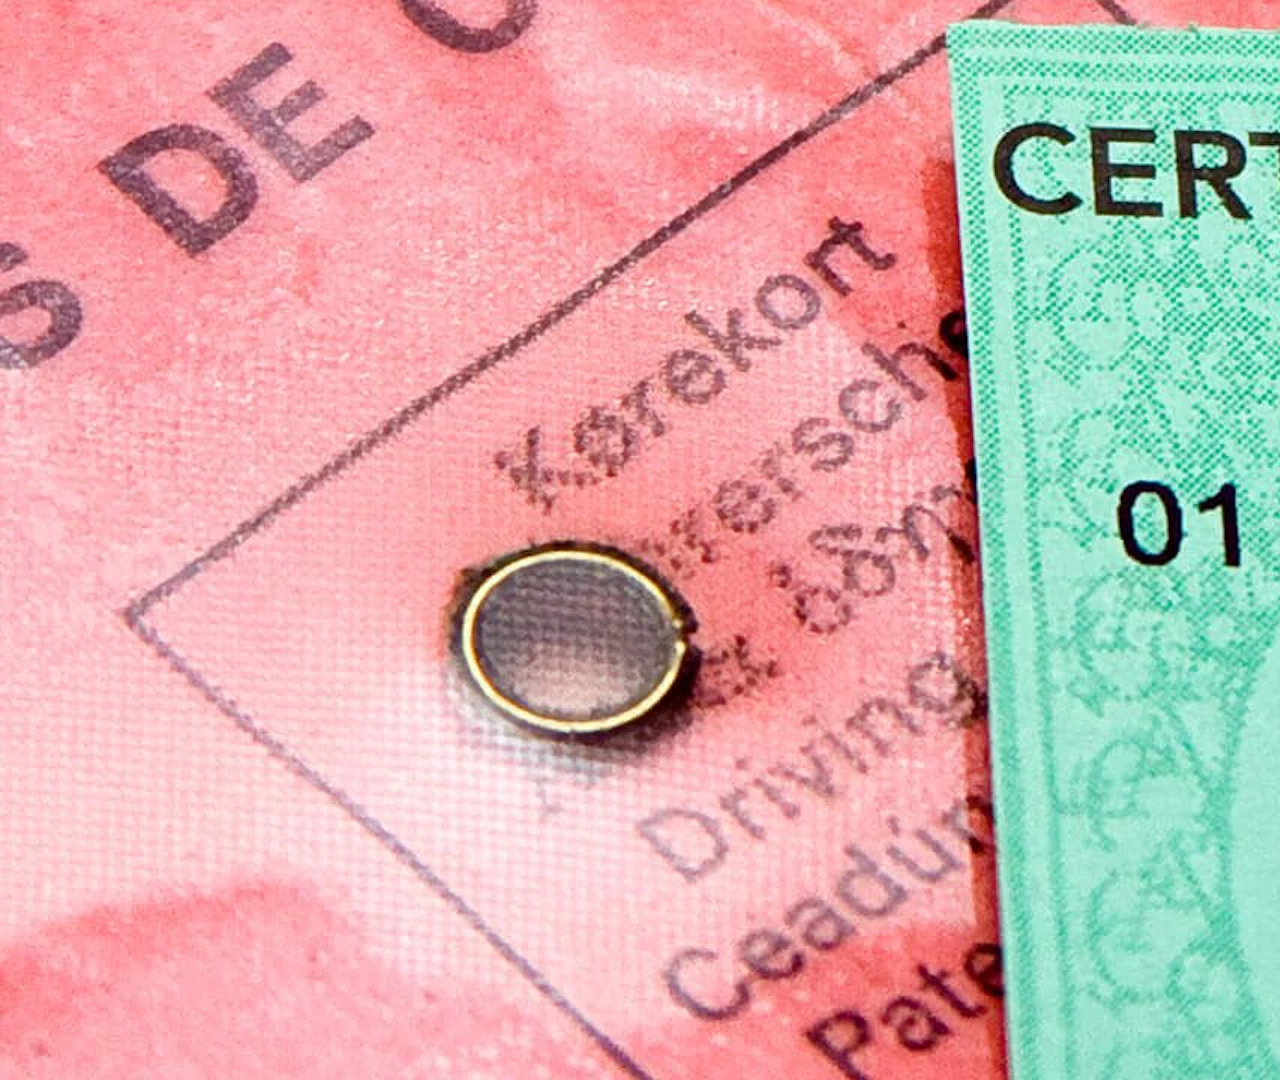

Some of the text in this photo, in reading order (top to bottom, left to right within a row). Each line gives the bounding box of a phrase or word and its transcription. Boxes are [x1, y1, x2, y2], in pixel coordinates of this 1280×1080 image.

[98, 41, 376, 259] DE
[496, 216, 898, 512] Kørekort
[1115, 479, 1243, 569] 01
